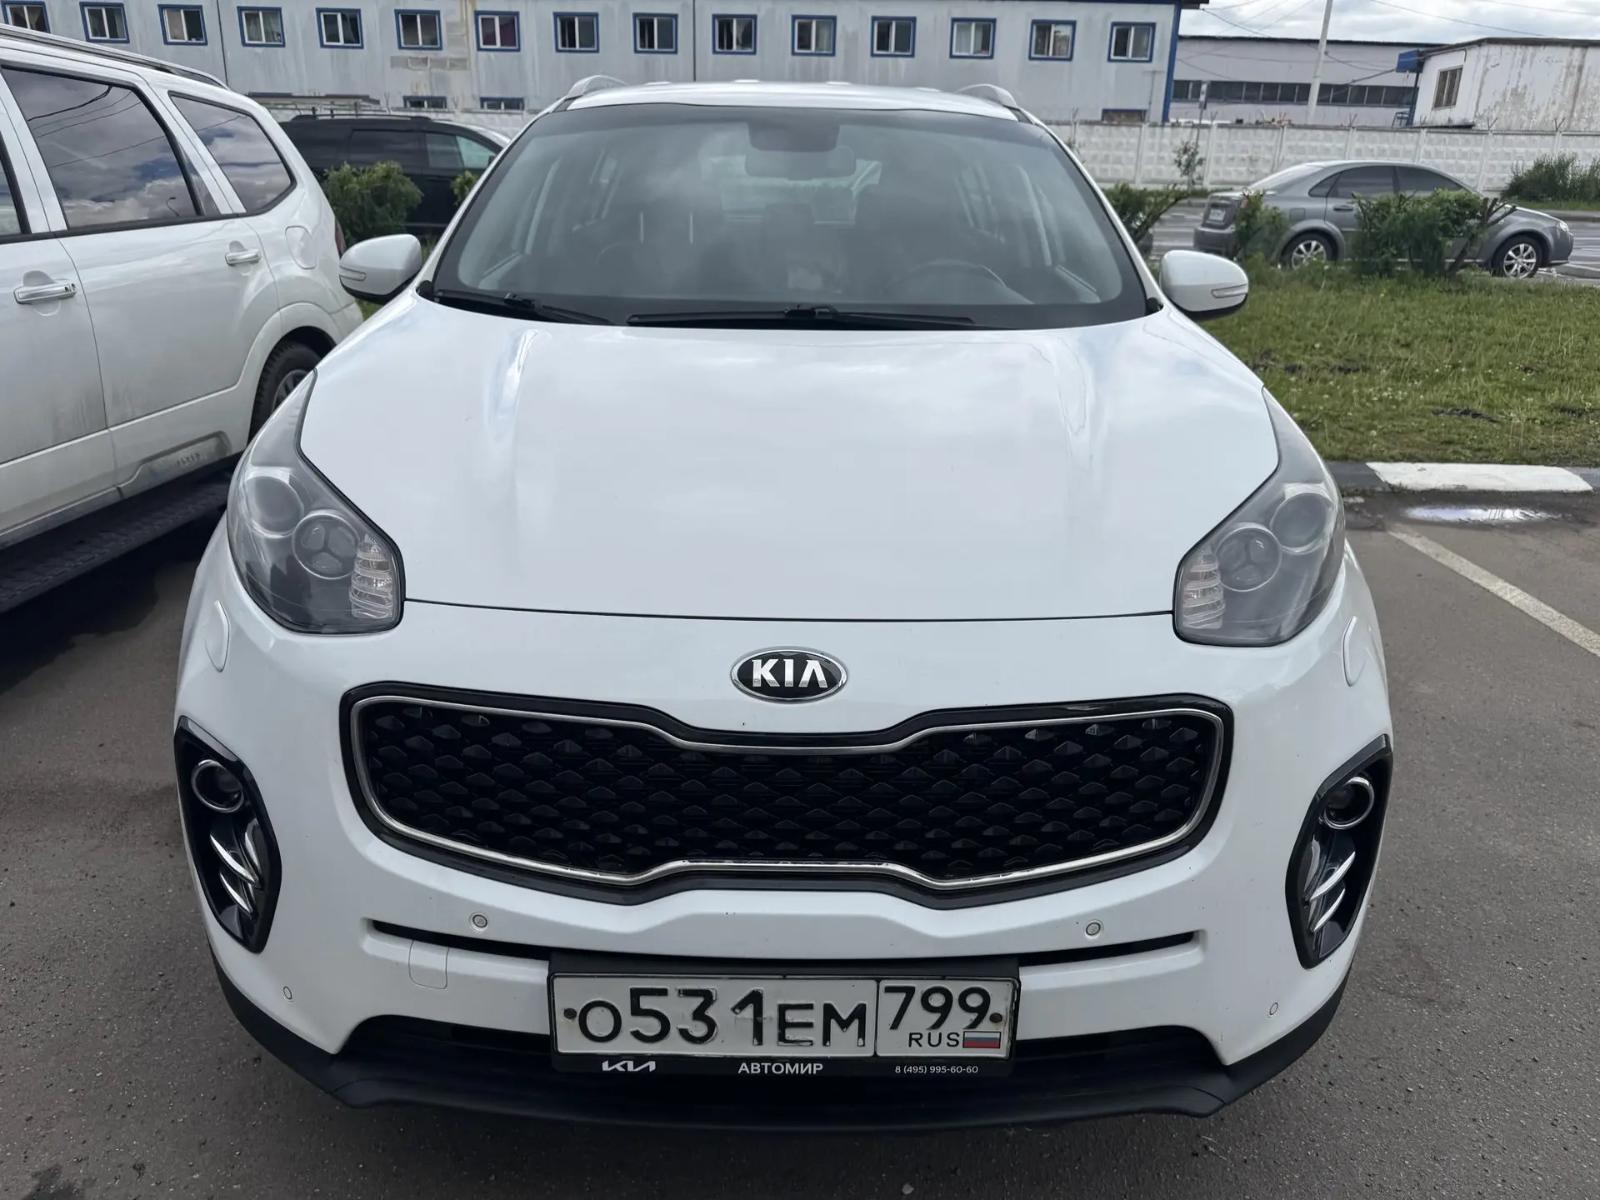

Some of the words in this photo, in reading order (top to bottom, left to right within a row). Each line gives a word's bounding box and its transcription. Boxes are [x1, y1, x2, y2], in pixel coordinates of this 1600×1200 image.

[751, 658, 829, 689] KIA
[884, 985, 991, 1031] 799
[908, 1031, 961, 1048] RUS
[737, 1062, 824, 1075] АВТОМИР
[895, 1065, 901, 1074] 8
[903, 1064, 928, 1075] (495)
[929, 1065, 979, 1075] 995-60-60
